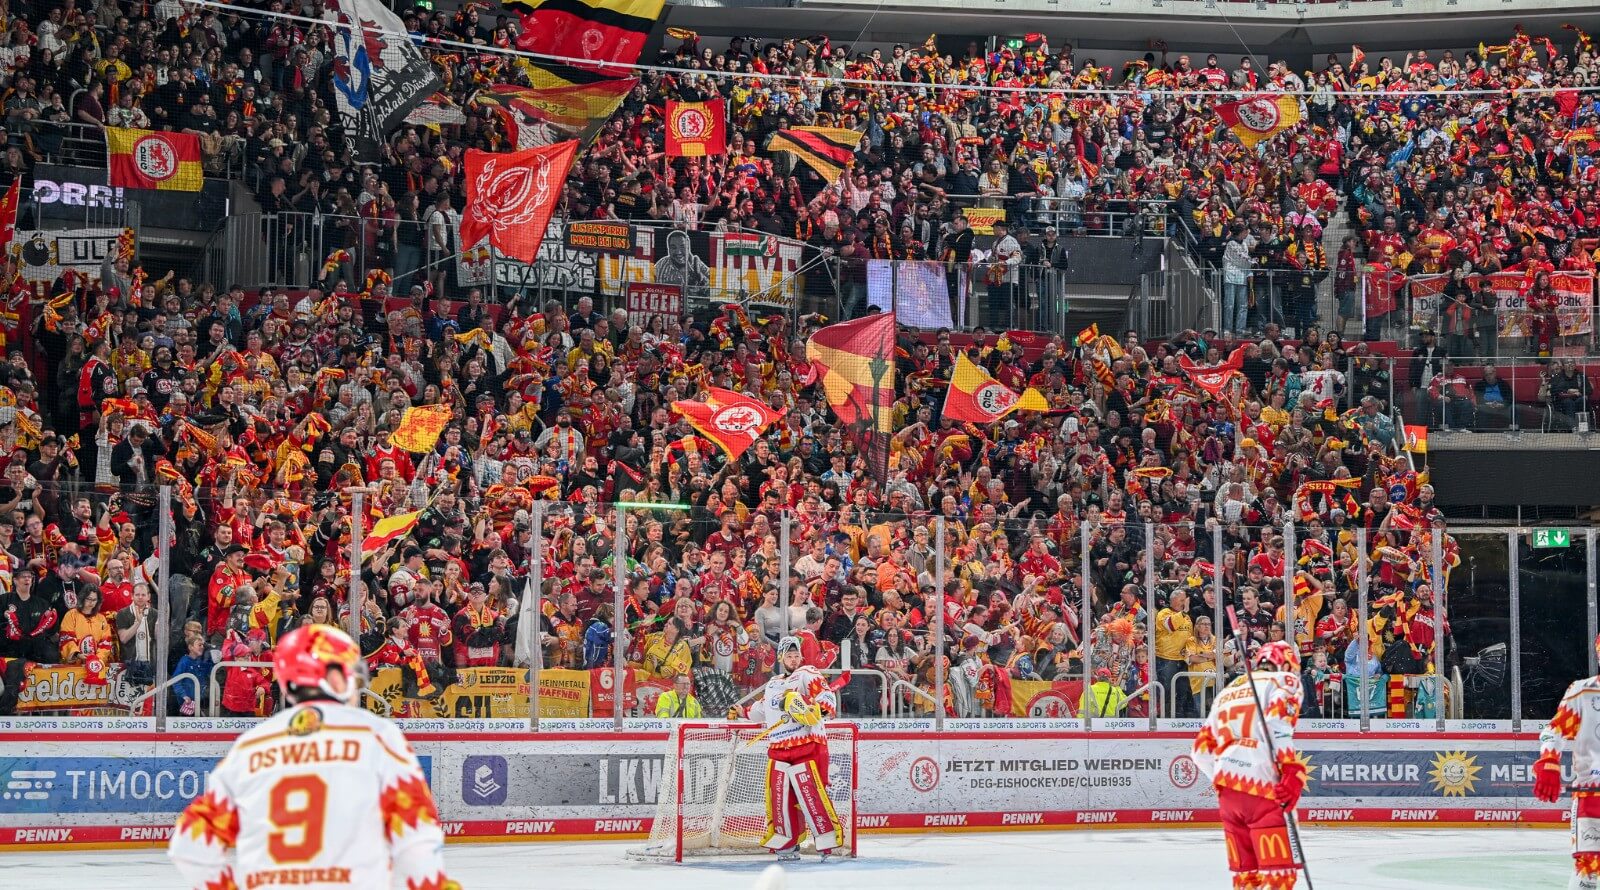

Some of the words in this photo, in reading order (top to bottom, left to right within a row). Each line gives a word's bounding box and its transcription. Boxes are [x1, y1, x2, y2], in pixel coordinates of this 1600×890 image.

[630, 292, 679, 312] GEGEN
[480, 675, 515, 685] LEIPZIG
[539, 678, 586, 690] HEINMETALL
[518, 684, 581, 701] ENWAFFNEN
[250, 739, 361, 773] OSWALD
[946, 761, 995, 773] JETZT
[1000, 759, 1079, 772] MITGLIED
[1084, 758, 1161, 771] WERDEN!
[1321, 764, 1419, 782] MERKUR
[268, 774, 328, 864] 9
